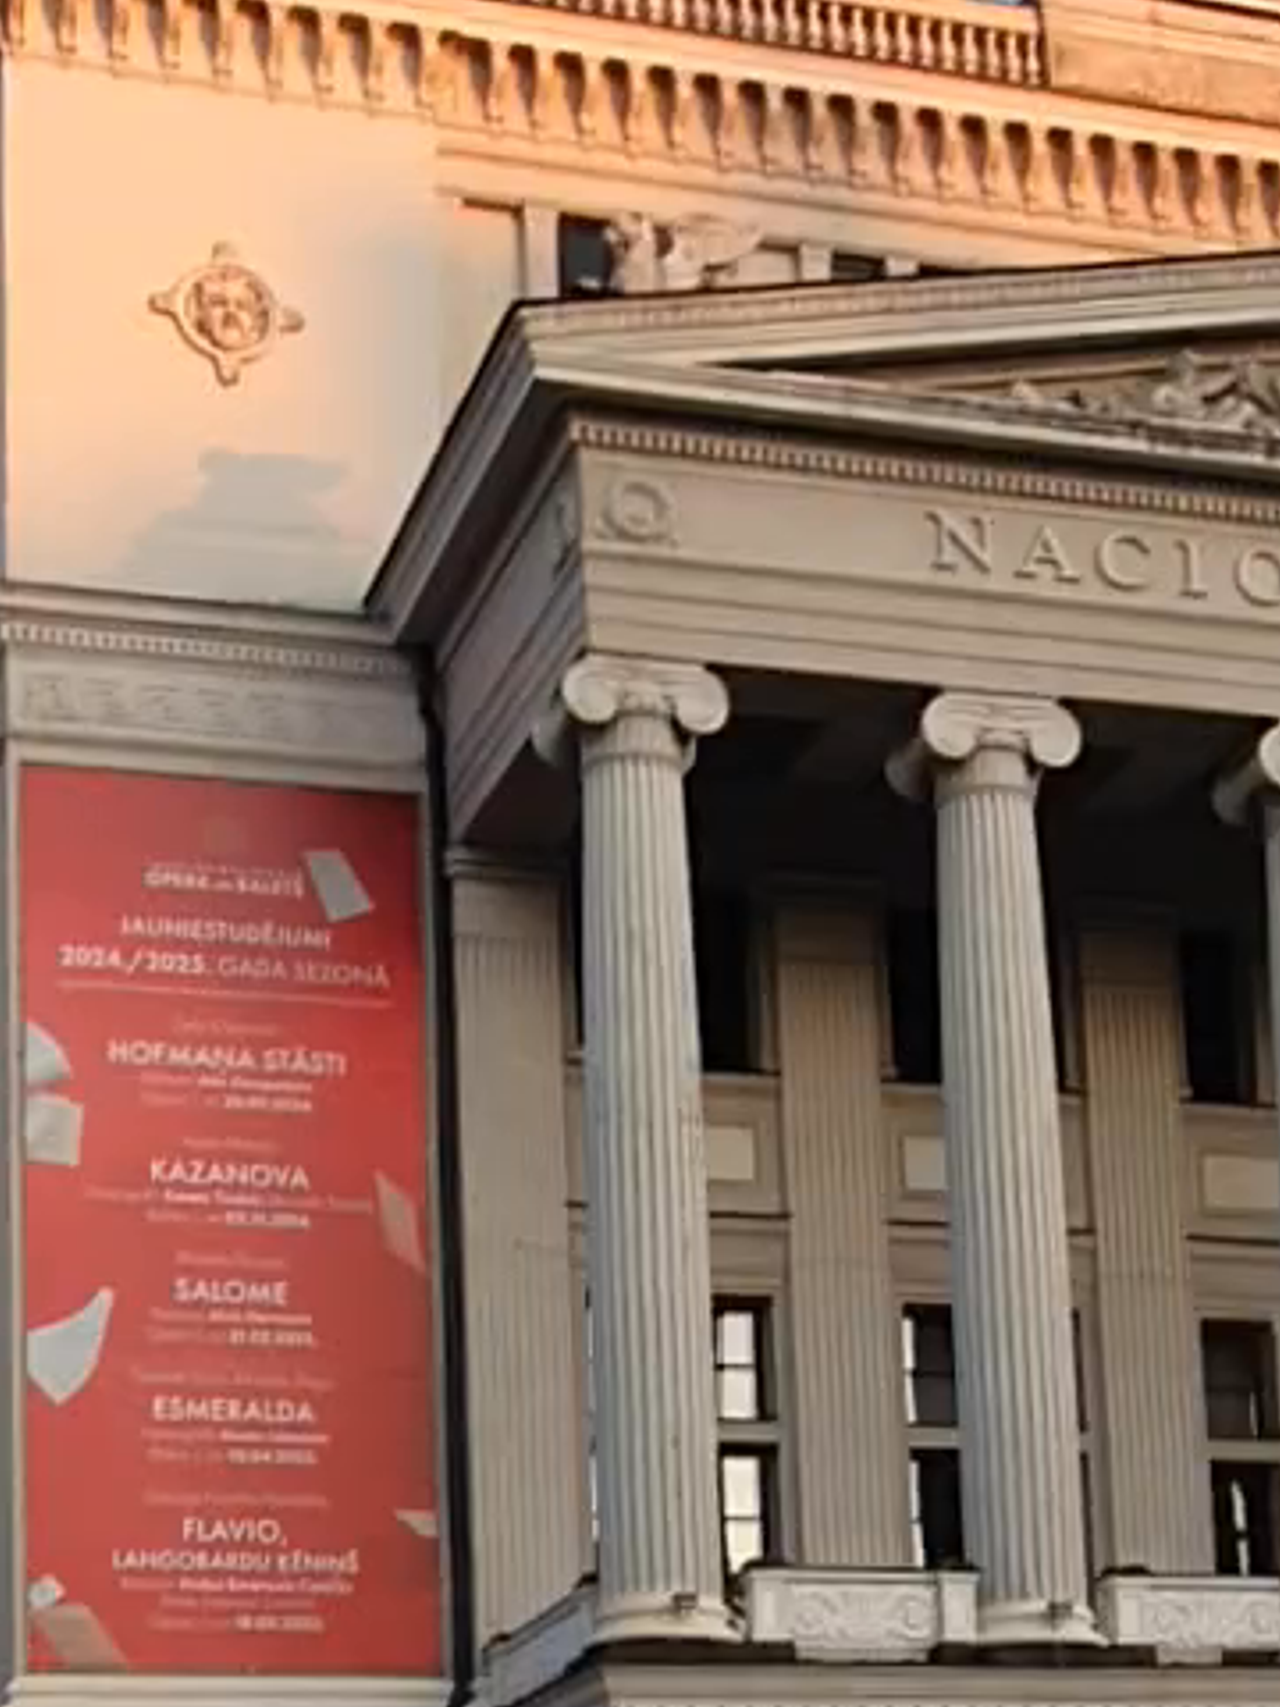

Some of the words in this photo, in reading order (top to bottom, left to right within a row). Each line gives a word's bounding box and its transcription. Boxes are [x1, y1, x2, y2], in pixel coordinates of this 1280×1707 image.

[218, 954, 287, 982] GADA
[150, 1157, 310, 1190] KAZANOVA
[173, 1277, 288, 1305] SALOME
[152, 1395, 316, 1422] ESMERALDA
[182, 1517, 288, 1548] FLAVIO,
